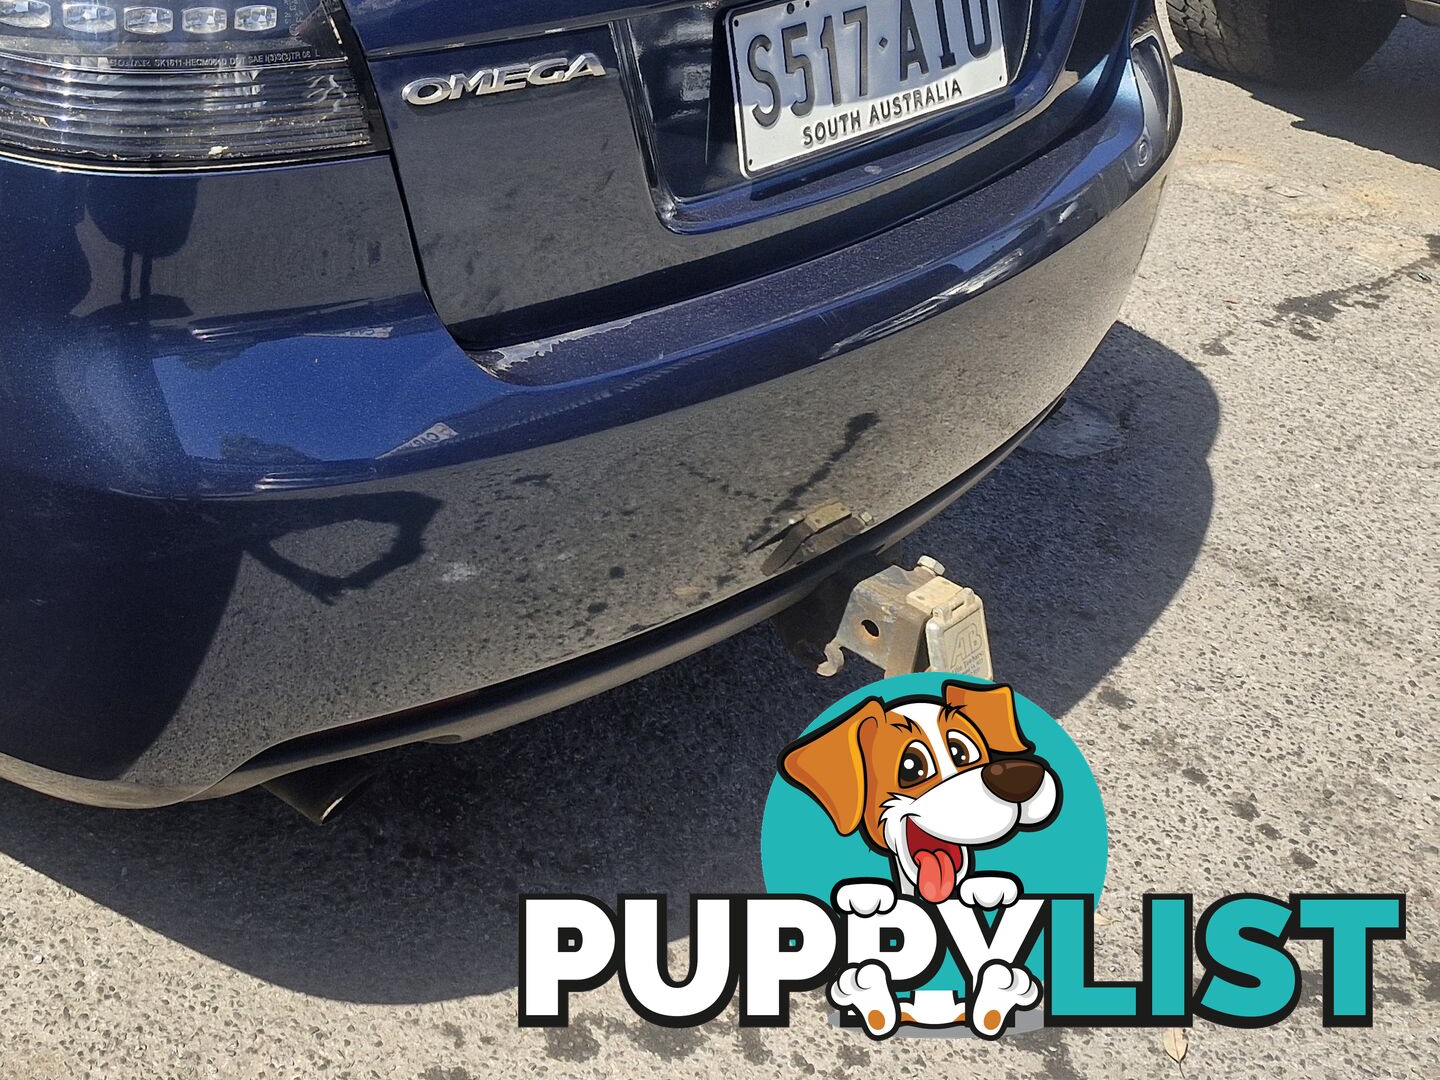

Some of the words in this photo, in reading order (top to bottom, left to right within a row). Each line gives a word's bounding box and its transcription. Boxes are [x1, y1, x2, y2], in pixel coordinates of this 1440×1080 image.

[401, 53, 606, 106] OMEGA
[802, 108, 862, 147] SOUTH
[868, 77, 963, 124] AUSTRALIA
